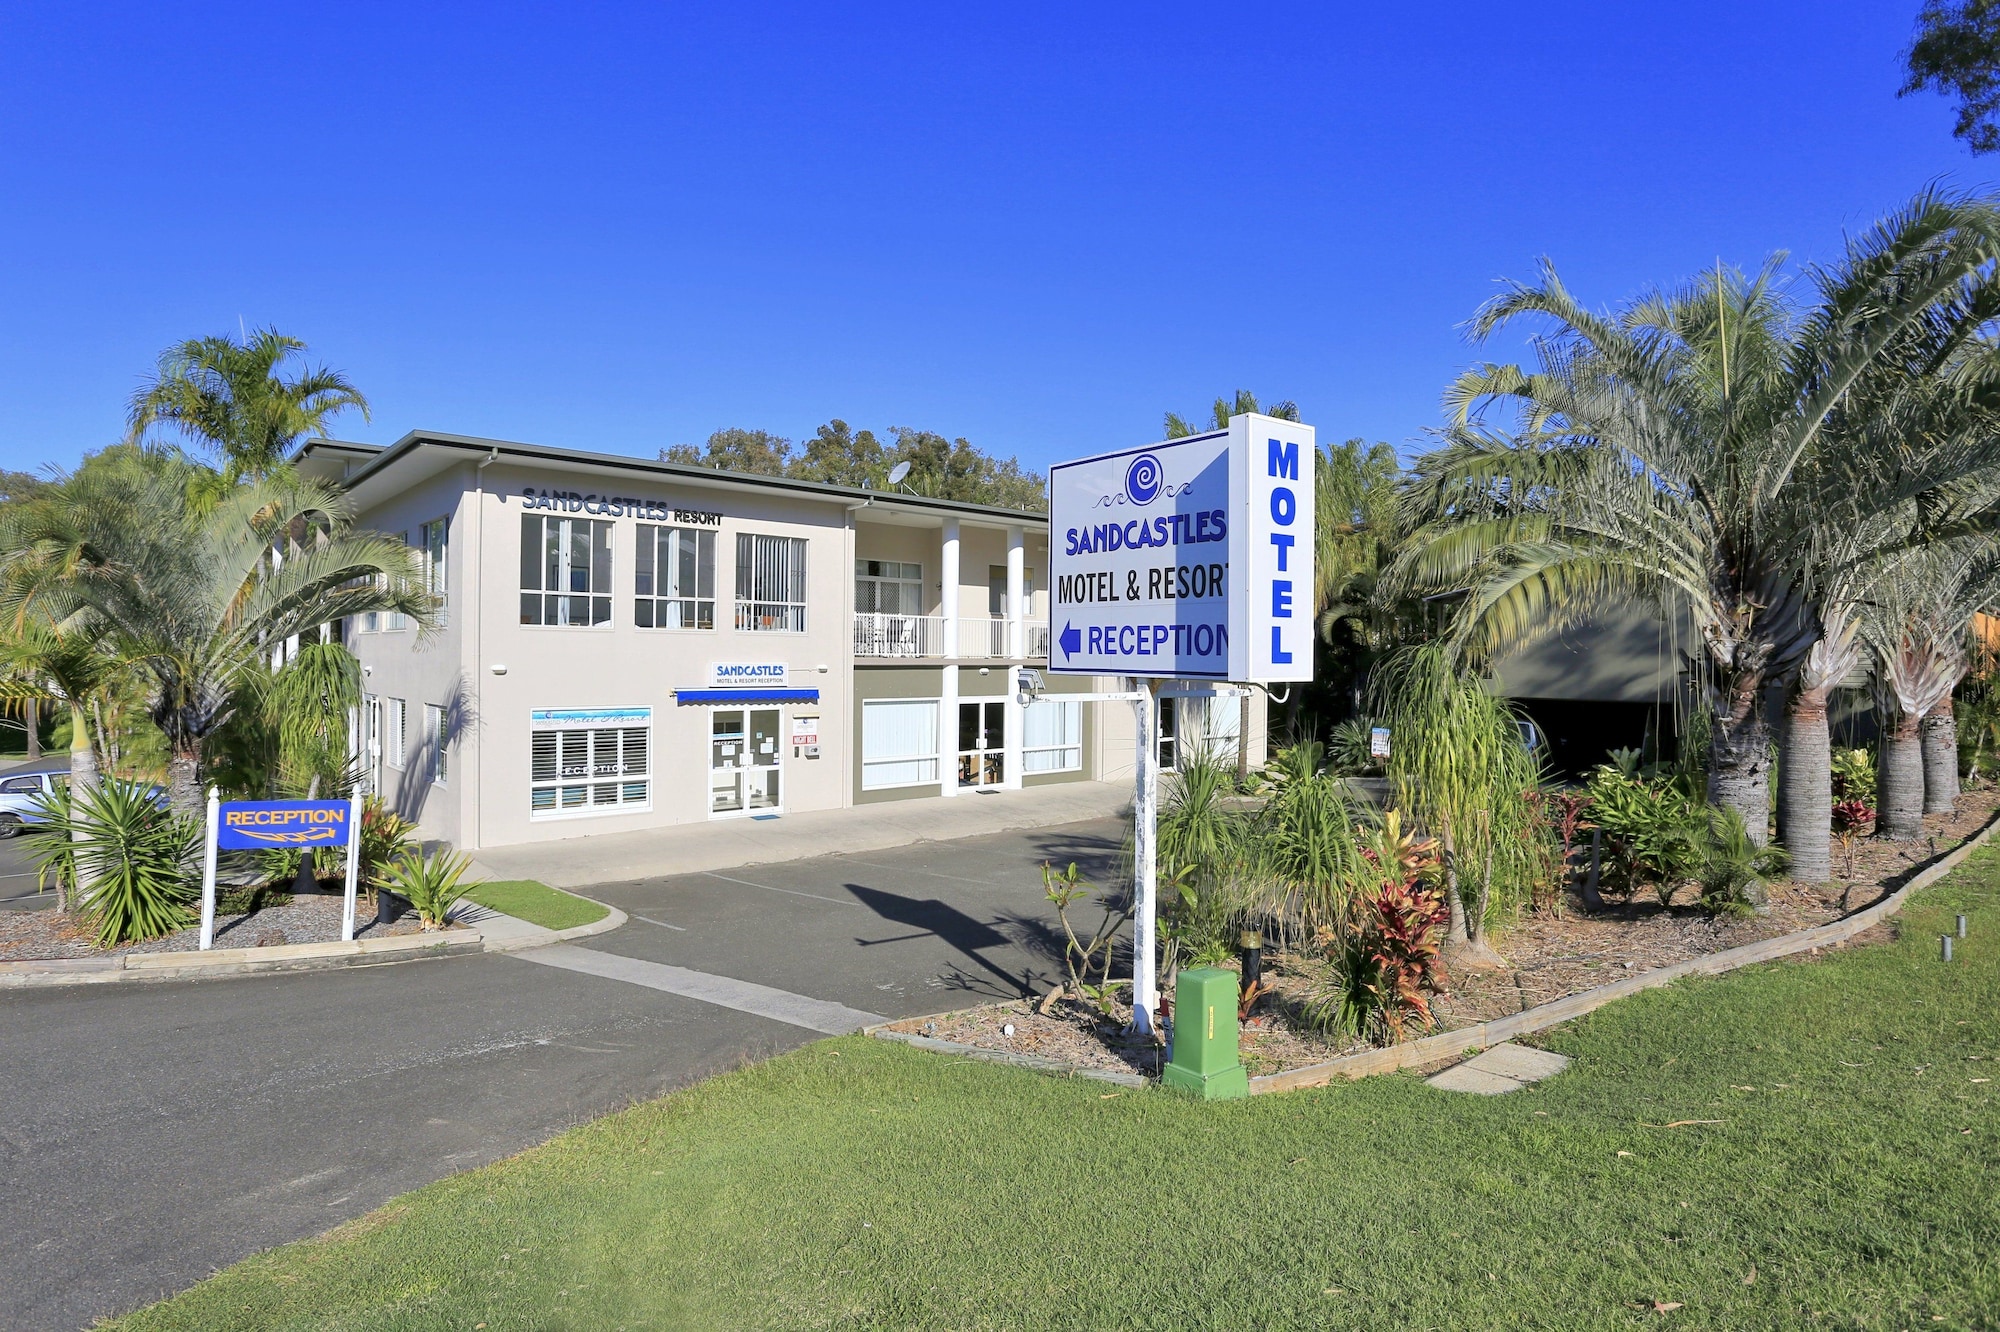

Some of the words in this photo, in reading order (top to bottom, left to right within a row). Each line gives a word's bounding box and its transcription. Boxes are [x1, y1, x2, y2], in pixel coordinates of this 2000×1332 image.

[522, 487, 669, 521] SANDCASTLES
[673, 508, 724, 527] RESORT
[1065, 509, 1227, 556] SANDCASTLES
[1267, 438, 1299, 664] MOTEL
[1058, 571, 1120, 604] MOTEL
[1126, 569, 1140, 601] &
[1148, 562, 1229, 600] RESOR
[716, 665, 784, 676] SANDCASTLES
[563, 715, 596, 724] Motel
[612, 713, 647, 722] Resort
[226, 809, 344, 826] RECEPTION
